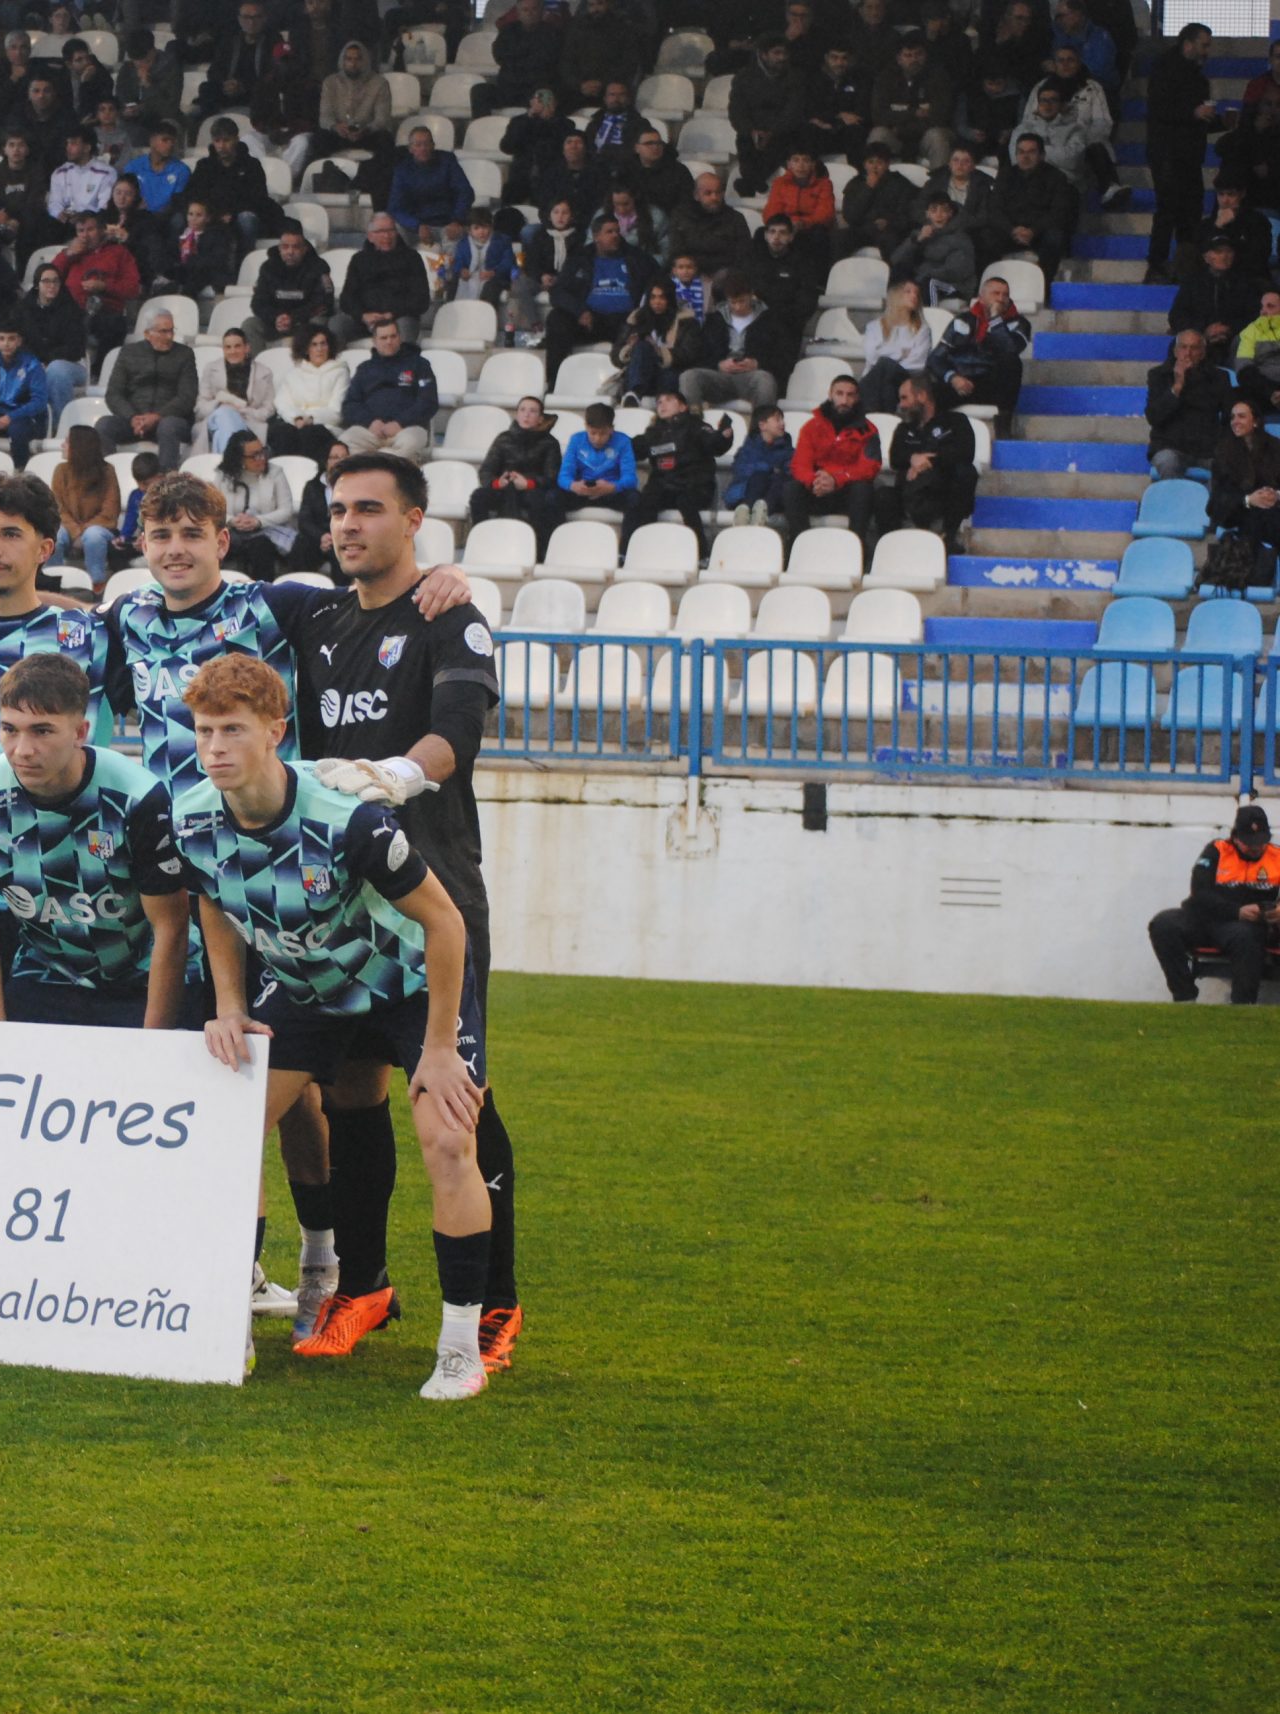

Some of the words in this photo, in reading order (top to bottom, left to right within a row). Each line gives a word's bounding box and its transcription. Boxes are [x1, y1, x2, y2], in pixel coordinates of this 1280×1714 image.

[341, 689, 388, 725] ASC
[39, 892, 128, 924] ASC
[255, 922, 332, 957] ASC
[6, 1188, 71, 1242] 81
